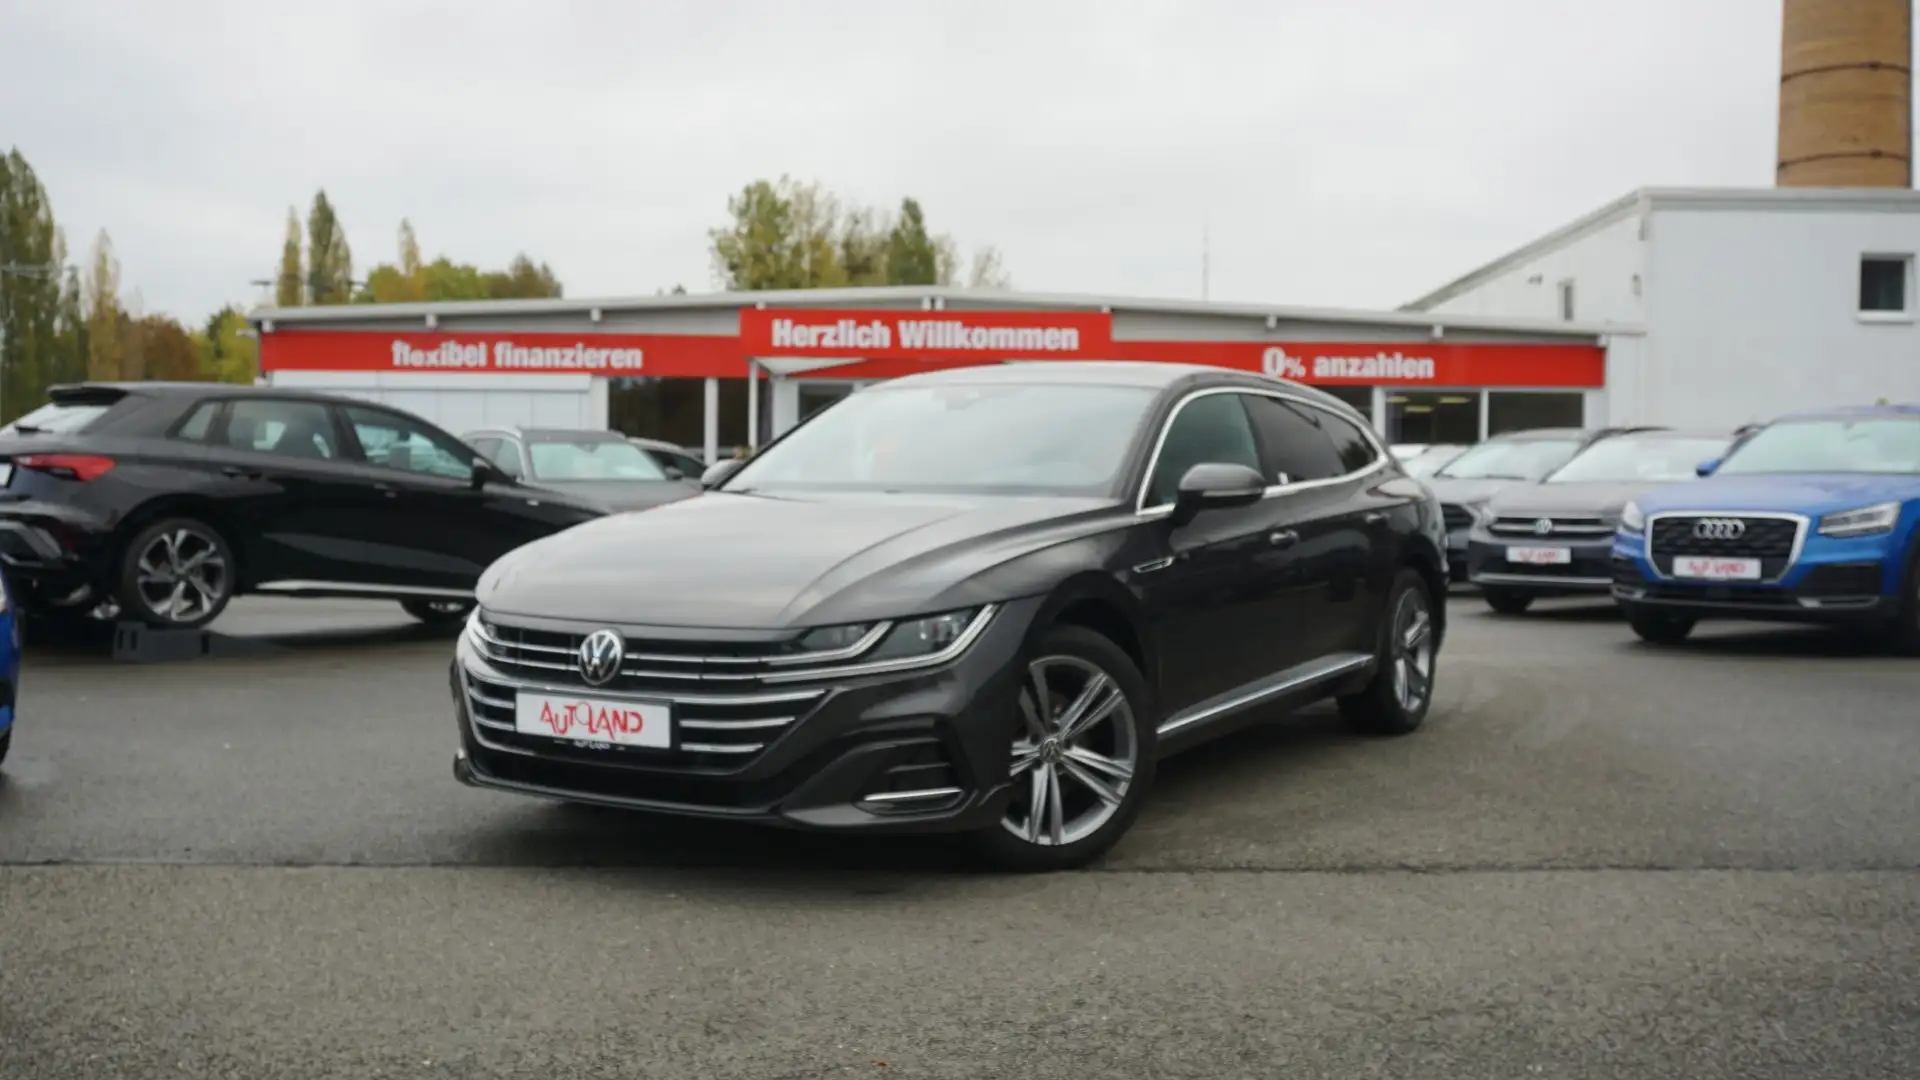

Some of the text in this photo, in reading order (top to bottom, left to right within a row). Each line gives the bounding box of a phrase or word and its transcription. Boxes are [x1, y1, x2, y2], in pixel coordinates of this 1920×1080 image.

[771, 319, 1079, 350] Herzlich Willkommen
[391, 340, 643, 369] flexibel finanzieren
[1263, 347, 1435, 379] 0% anzahlen
[540, 700, 643, 741] AUTOLAND
